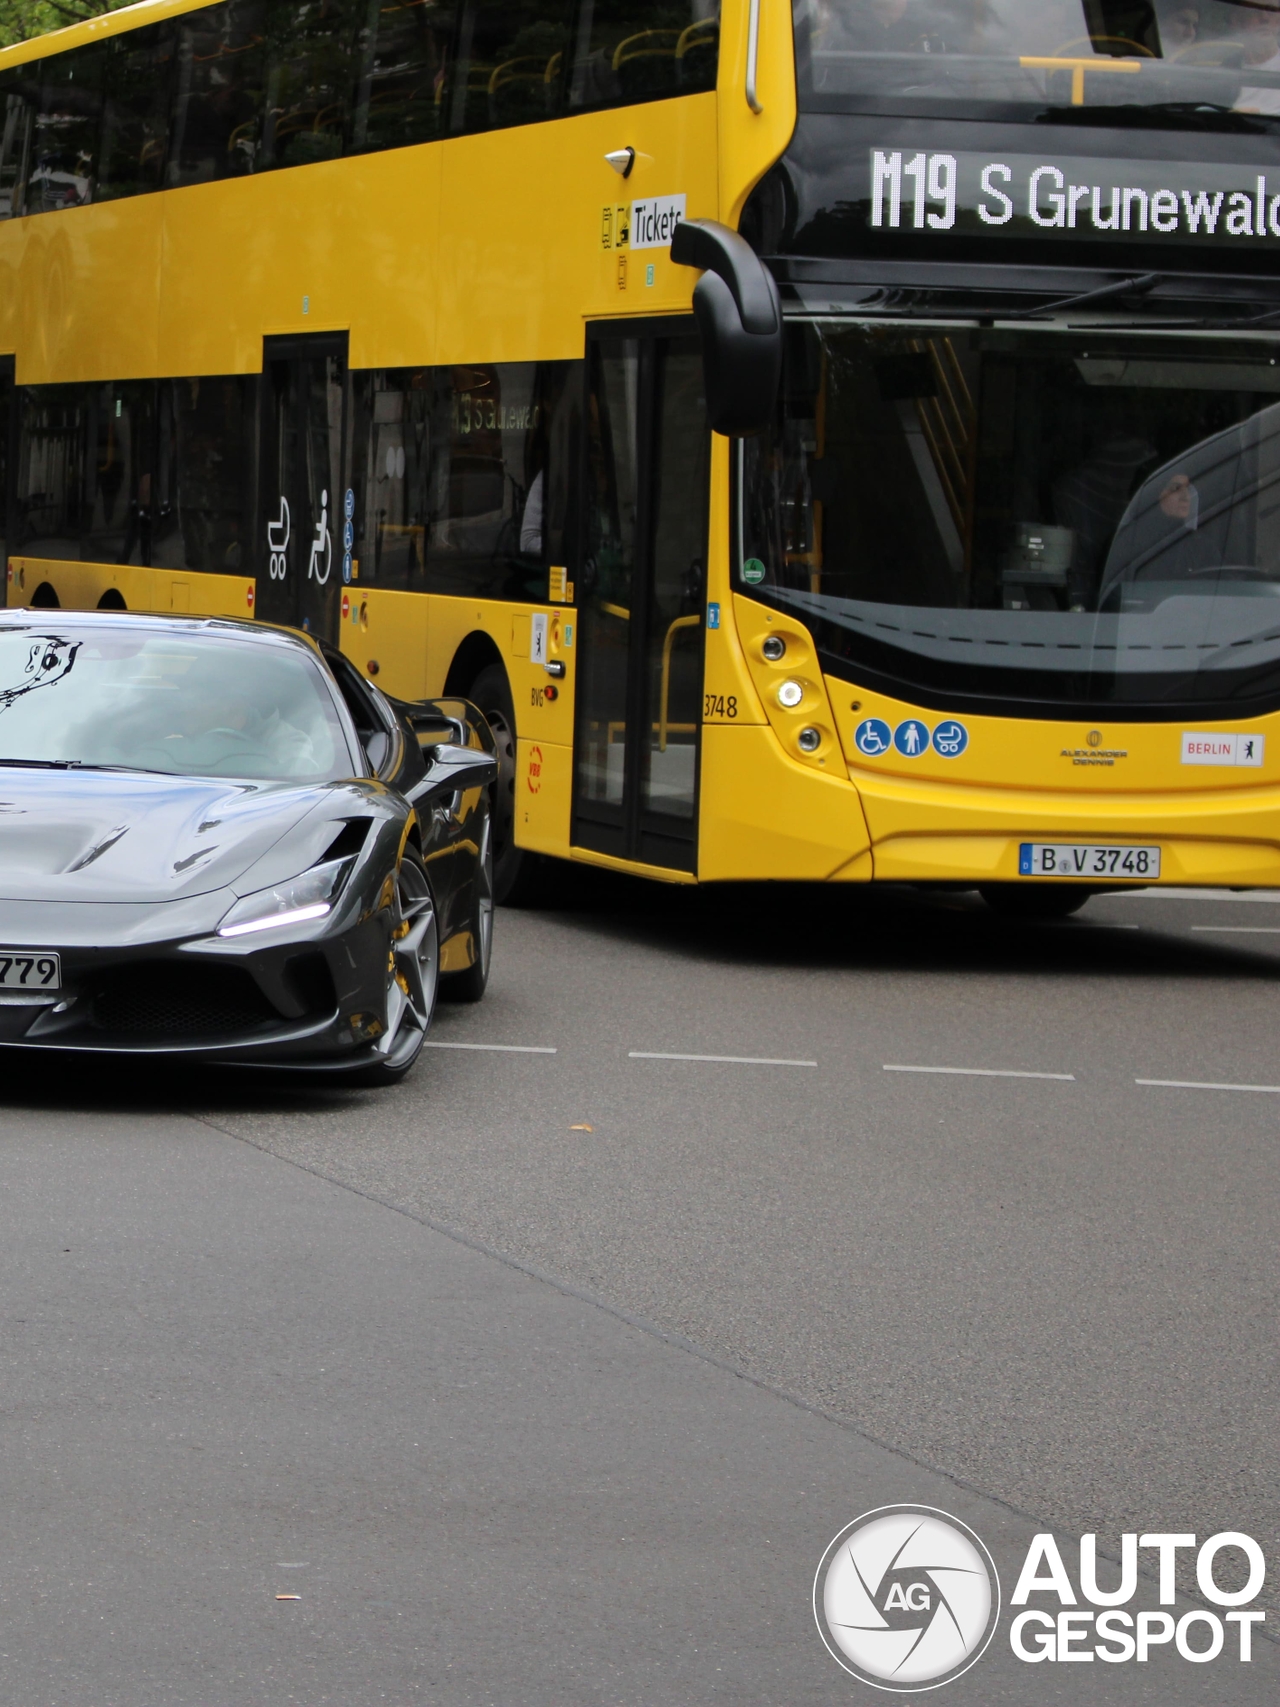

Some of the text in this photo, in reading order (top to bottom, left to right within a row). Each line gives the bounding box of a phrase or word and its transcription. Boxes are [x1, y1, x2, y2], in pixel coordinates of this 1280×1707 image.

[871, 151, 957, 230] M19
[977, 163, 1014, 226] S
[531, 687, 544, 707] BVG
[704, 694, 738, 718] 3748
[1060, 748, 1128, 758] ALEXANDER
[1187, 742, 1232, 755] BERLIN
[1072, 758, 1115, 767] DENNIS
[1041, 848, 1056, 871] B
[1073, 849, 1087, 872] V
[1093, 850, 1149, 873] 3748
